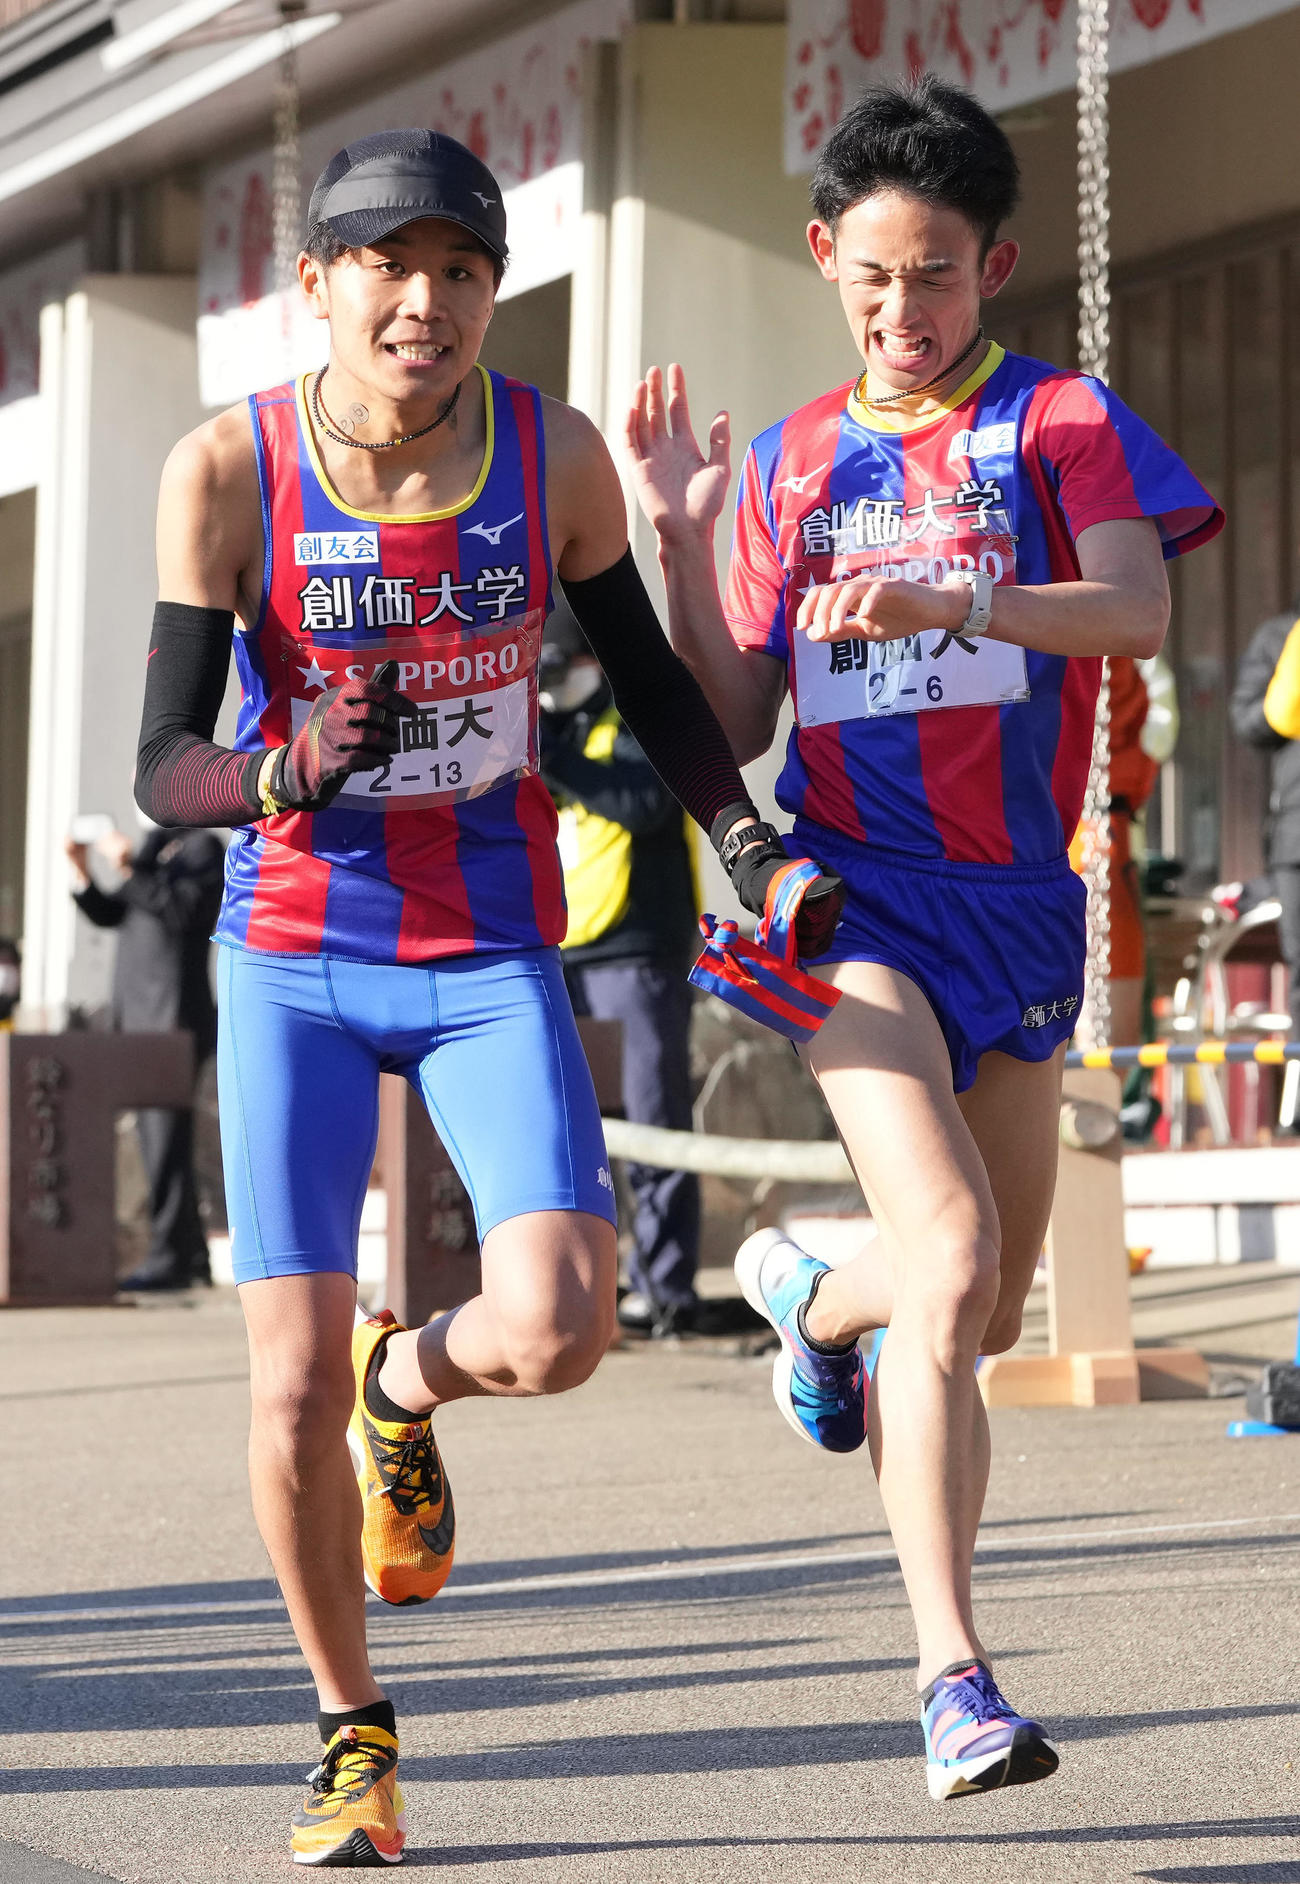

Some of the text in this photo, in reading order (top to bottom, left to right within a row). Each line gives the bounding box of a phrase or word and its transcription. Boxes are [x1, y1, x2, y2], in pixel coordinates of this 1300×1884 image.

[800, 480, 1002, 555] 創価大学
[298, 535, 375, 561] 創友会
[299, 565, 526, 631] 創価大学
[345, 643, 519, 692] SPPORO
[868, 672, 944, 709] 2-6
[401, 698, 494, 752] 価大
[368, 760, 463, 792] 2-13
